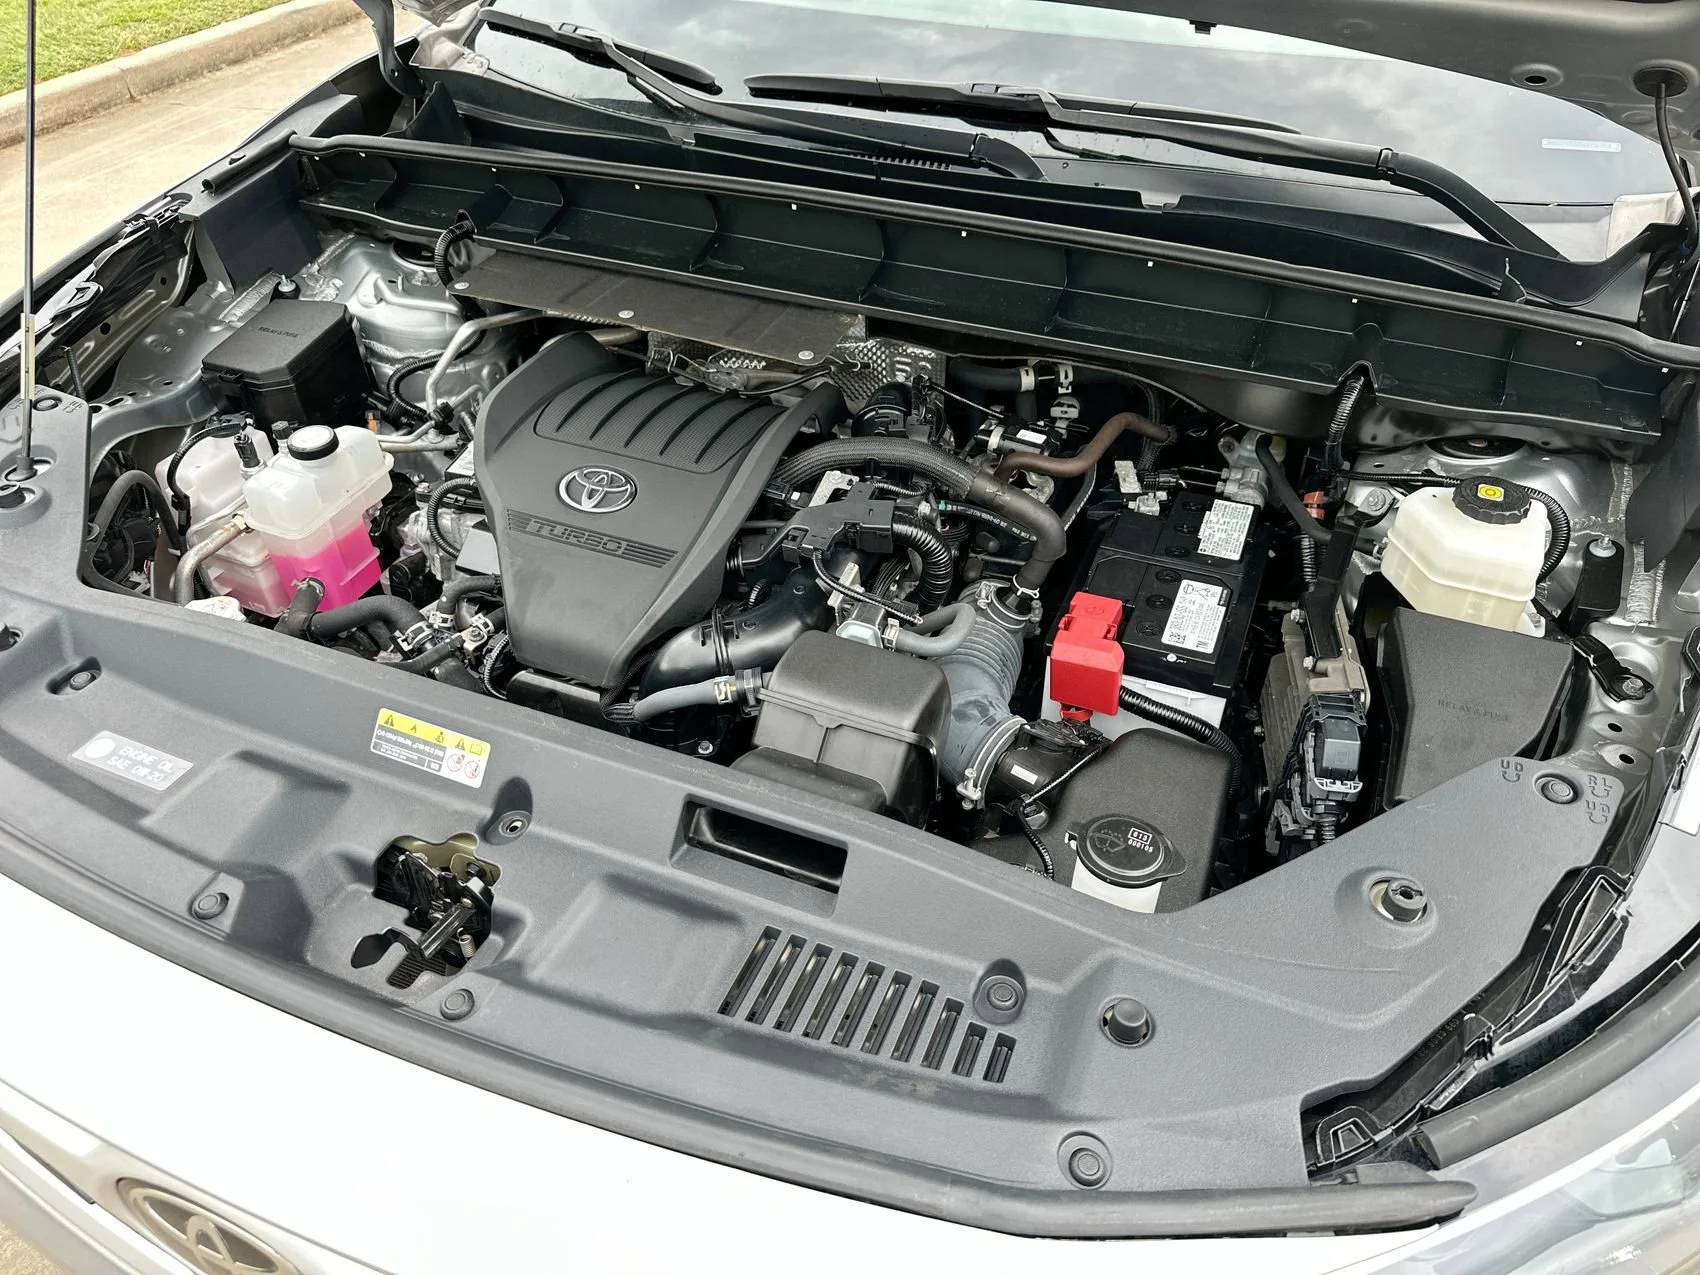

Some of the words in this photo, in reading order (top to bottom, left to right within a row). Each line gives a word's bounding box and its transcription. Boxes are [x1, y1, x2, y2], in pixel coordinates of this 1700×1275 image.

[533, 520, 622, 553] TURBO
[106, 755, 132, 770] SAE
[119, 745, 159, 765] ENGINE
